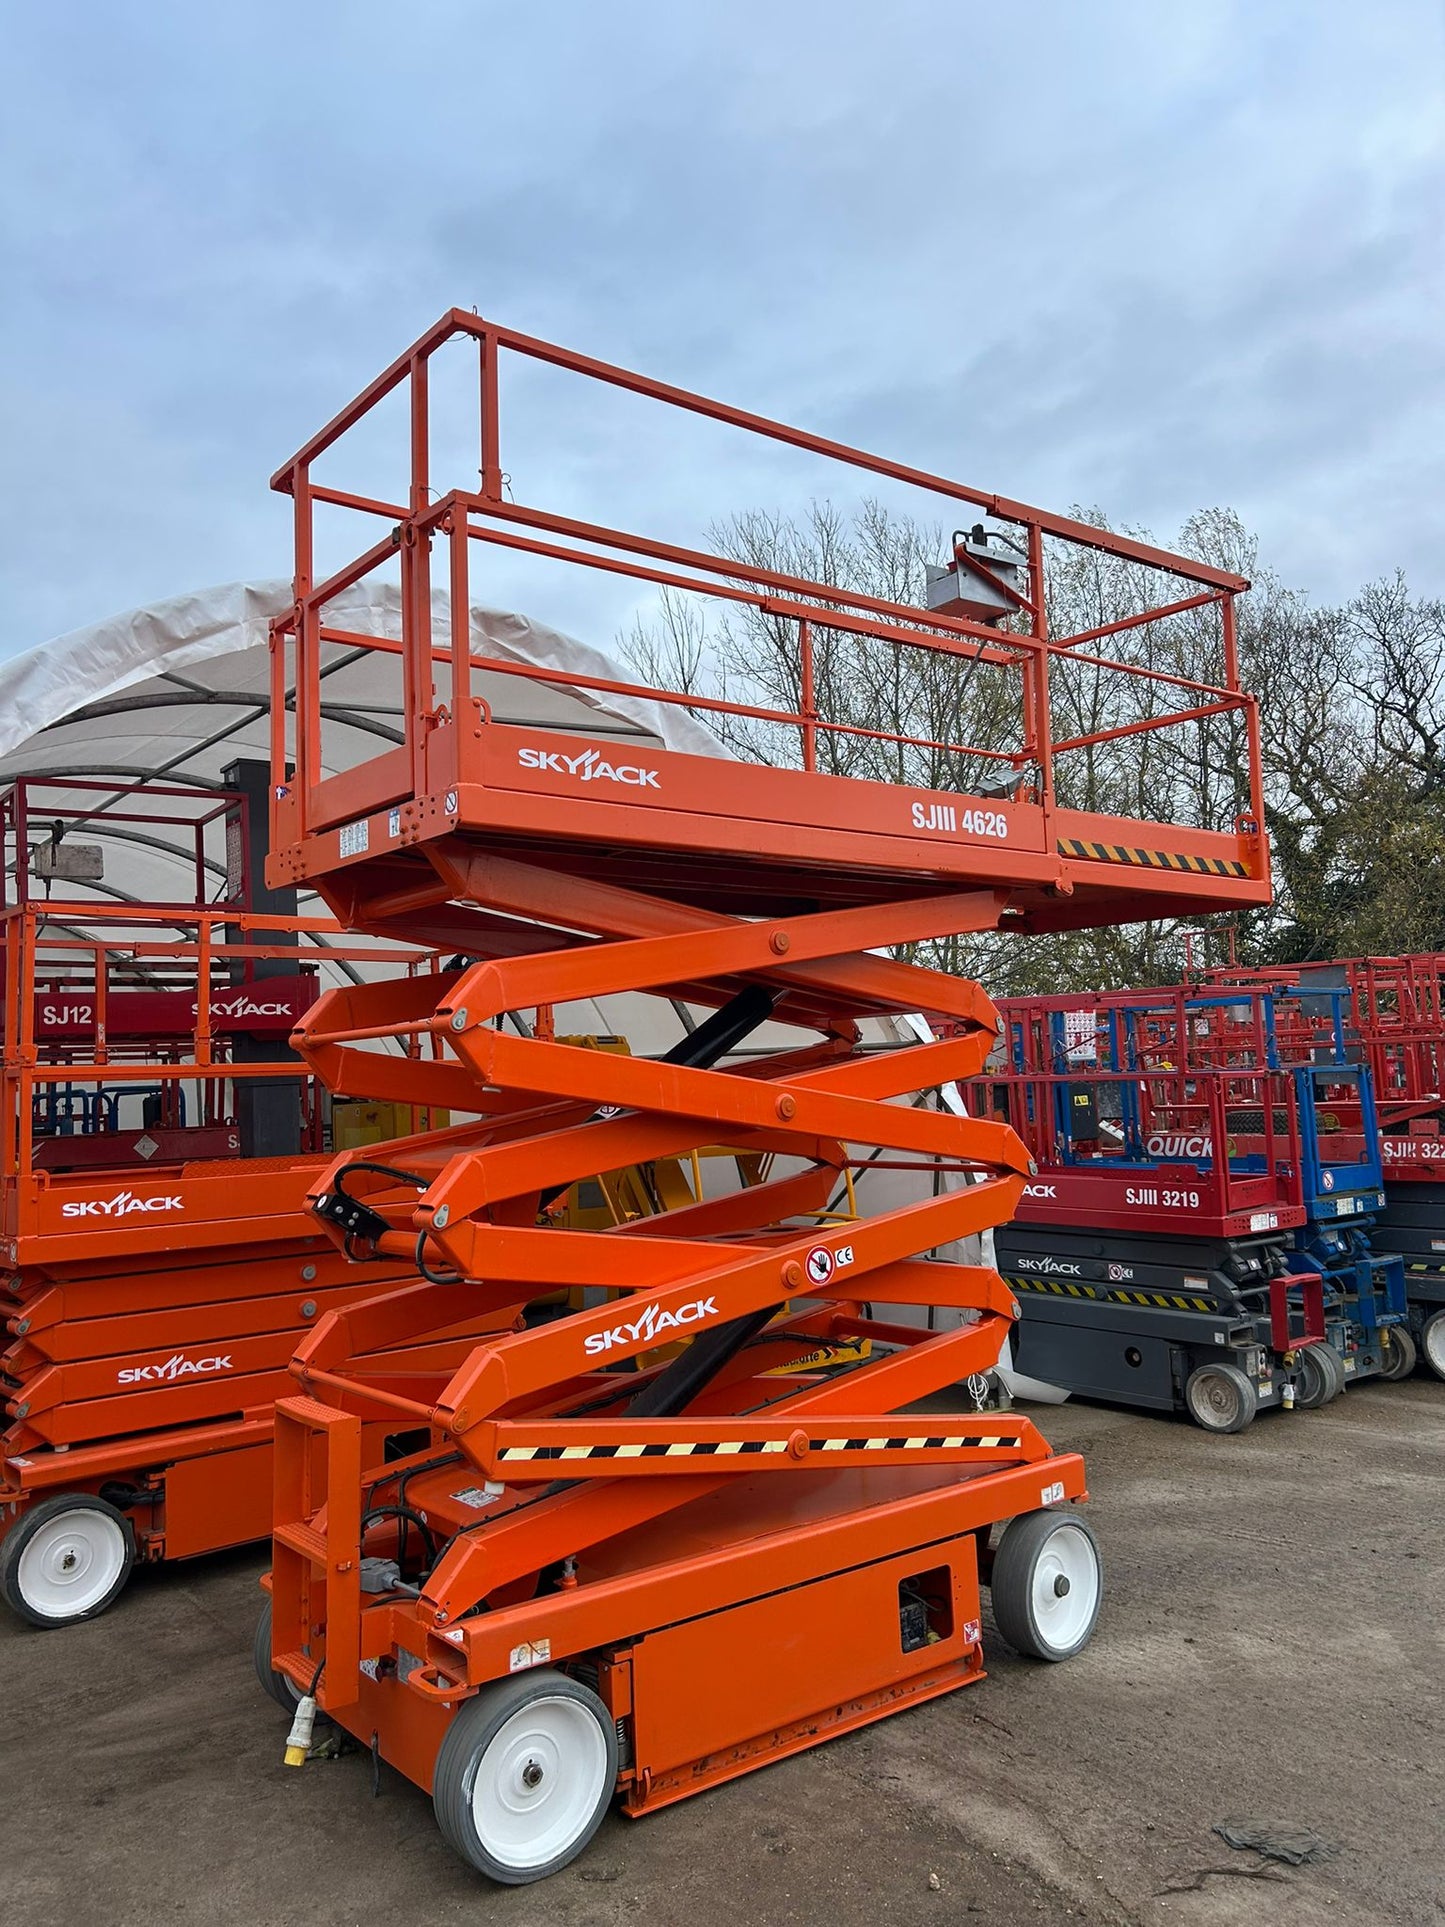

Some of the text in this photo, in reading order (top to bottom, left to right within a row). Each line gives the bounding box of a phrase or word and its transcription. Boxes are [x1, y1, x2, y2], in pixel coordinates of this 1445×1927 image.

[518, 748, 662, 789] SKYJACK
[911, 802, 1008, 838] SJIII 4626
[43, 1005, 92, 1025] SJ12
[1147, 1136, 1213, 1157] QUICK
[62, 1191, 185, 1217] SKYJACK
[1126, 1188, 1200, 1208] SJIII 3219
[836, 1247, 853, 1264] CE
[1018, 1256, 1081, 1275] SKYJACK
[584, 1296, 720, 1355] SKYJACK
[117, 1354, 234, 1384] SKYJACK
